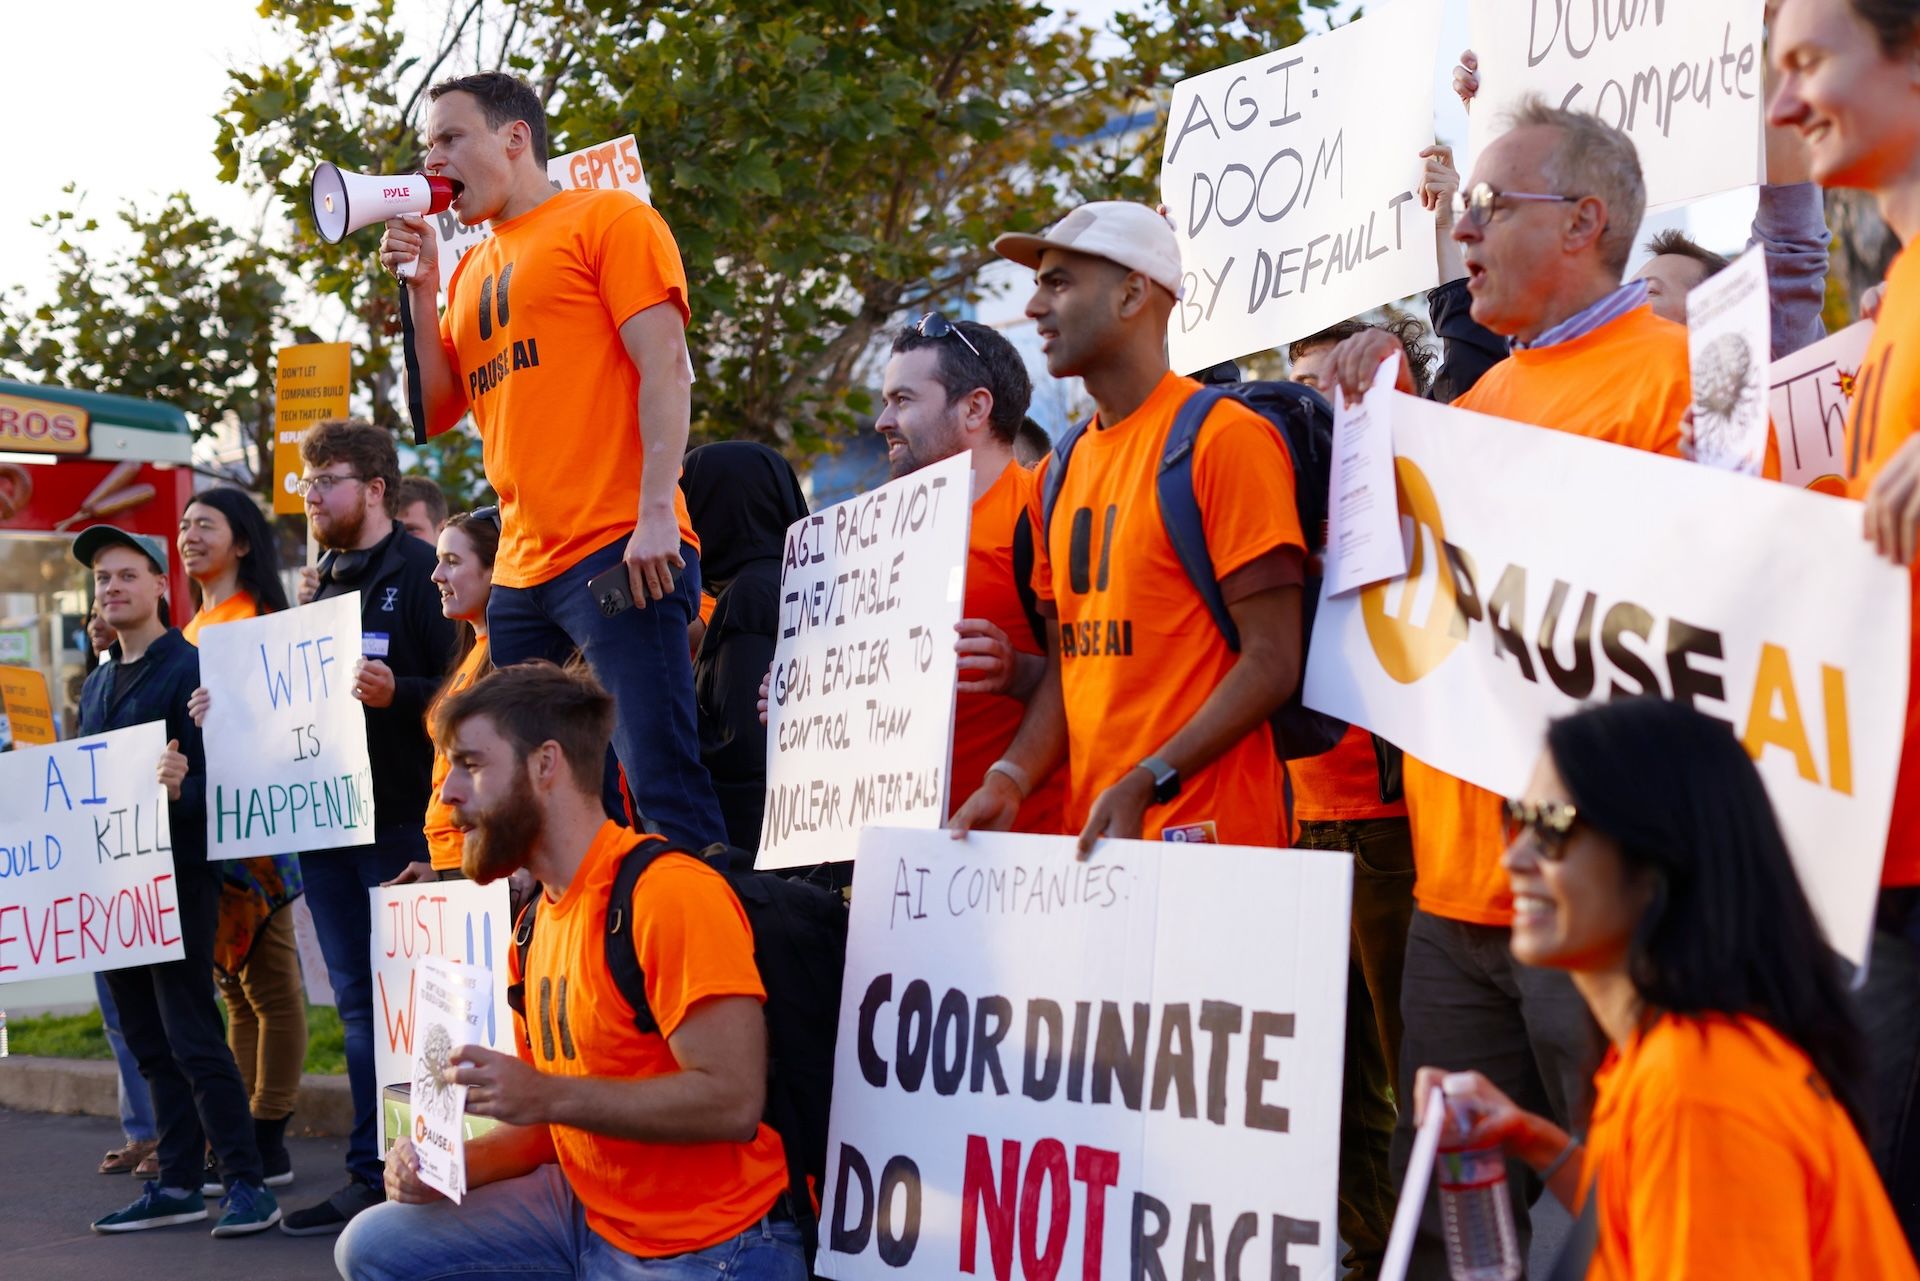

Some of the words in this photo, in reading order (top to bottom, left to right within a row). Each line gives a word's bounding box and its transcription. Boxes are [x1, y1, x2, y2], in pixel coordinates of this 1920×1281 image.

[1168, 56, 1319, 164] AGI:
[383, 187, 410, 198] PYLE
[569, 138, 642, 190] GPT-5
[1188, 128, 1344, 239] DOOM
[1180, 256, 1235, 334] BY
[1248, 191, 1413, 314] DEFAULT
[281, 386, 321, 400] COMPANIES
[323, 385, 344, 398] BUILD
[304, 366, 316, 377] LET
[469, 347, 510, 400] PAUSE
[513, 338, 540, 371] AI
[281, 410, 297, 422] TECH
[300, 408, 317, 420] THAT
[318, 407, 332, 419] CAN
[782, 516, 825, 586] AGI
[835, 492, 887, 558] RACE
[891, 477, 947, 539] NOT
[822, 638, 890, 696] EASIER
[909, 626, 933, 673] TO
[1105, 620, 1133, 656] AI
[1441, 538, 1734, 736] PAUSE
[1738, 640, 1856, 799] AI
[260, 637, 335, 711] WTF
[292, 724, 321, 762] IS
[779, 709, 850, 752] CONTROL
[866, 699, 912, 747] THAN
[44, 742, 108, 813] AI
[94, 799, 173, 864] KILL
[764, 779, 843, 851] NUCLEAR
[0, 874, 182, 972] EVERYONE
[386, 895, 448, 958] JUST
[890, 857, 931, 930] AI
[857, 972, 1296, 1133] COORDINATE
[830, 1141, 922, 1267] DO
[959, 1134, 1121, 1281] NOT
